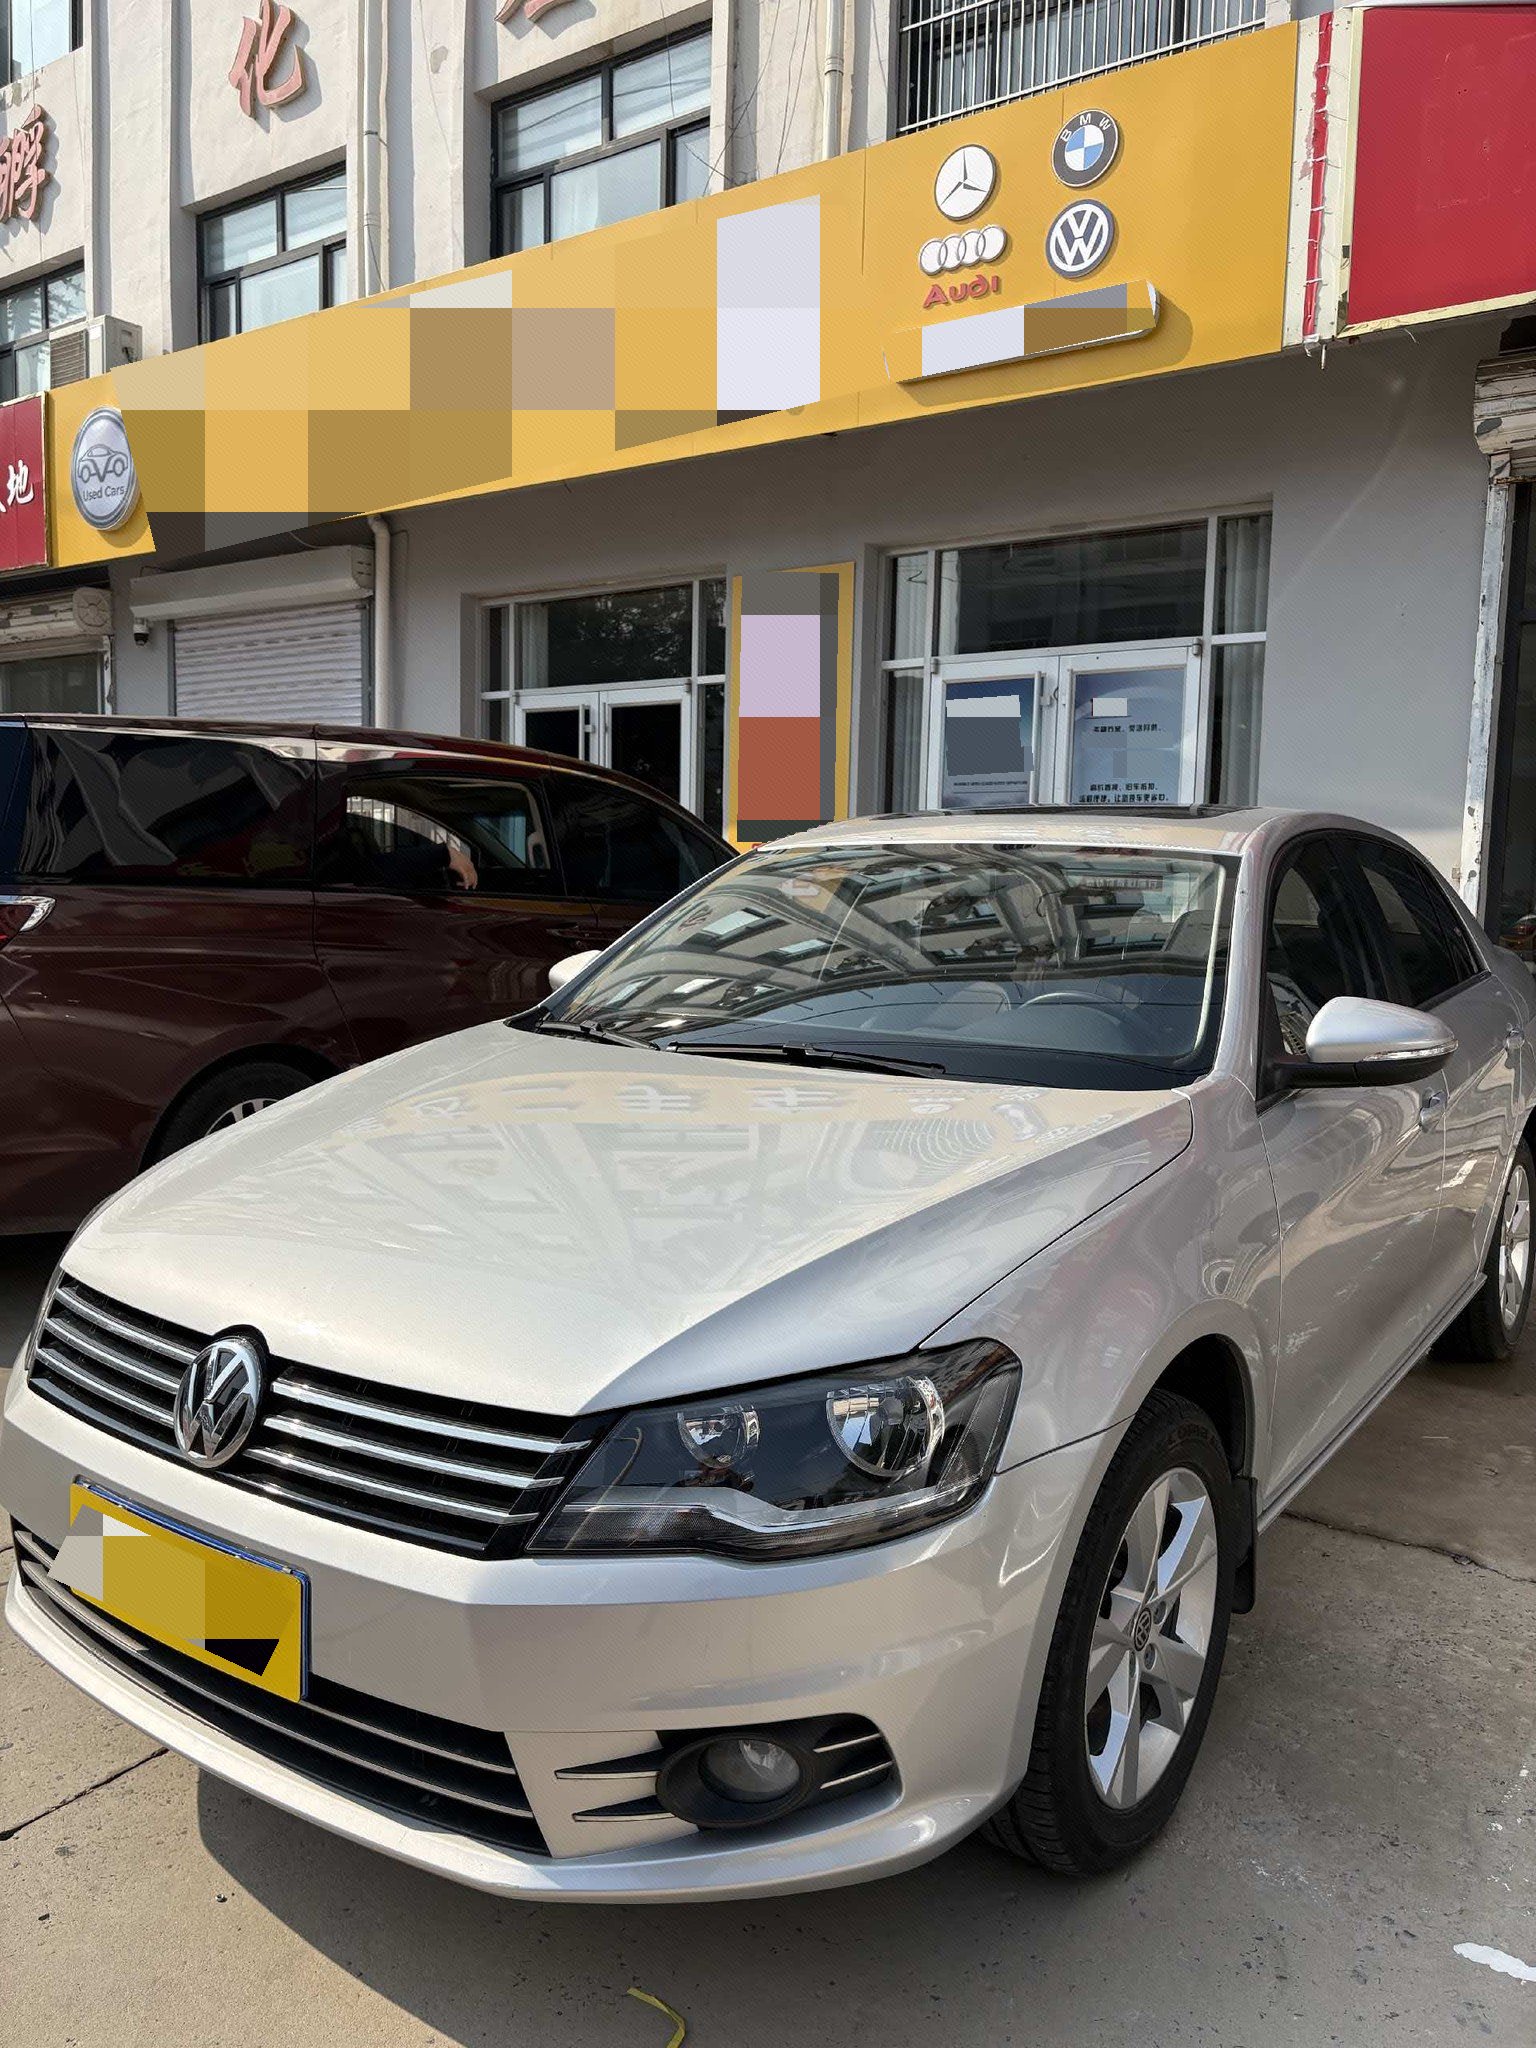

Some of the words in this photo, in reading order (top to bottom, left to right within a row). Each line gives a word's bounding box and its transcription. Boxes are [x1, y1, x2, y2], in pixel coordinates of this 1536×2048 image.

[228, 0, 304, 117] 化
[1060, 112, 1112, 142] BMW
[923, 274, 1000, 309] Audi
[0, 459, 35, 513] 地
[82, 487, 103, 502] Used
[104, 485, 125, 498] Cars
